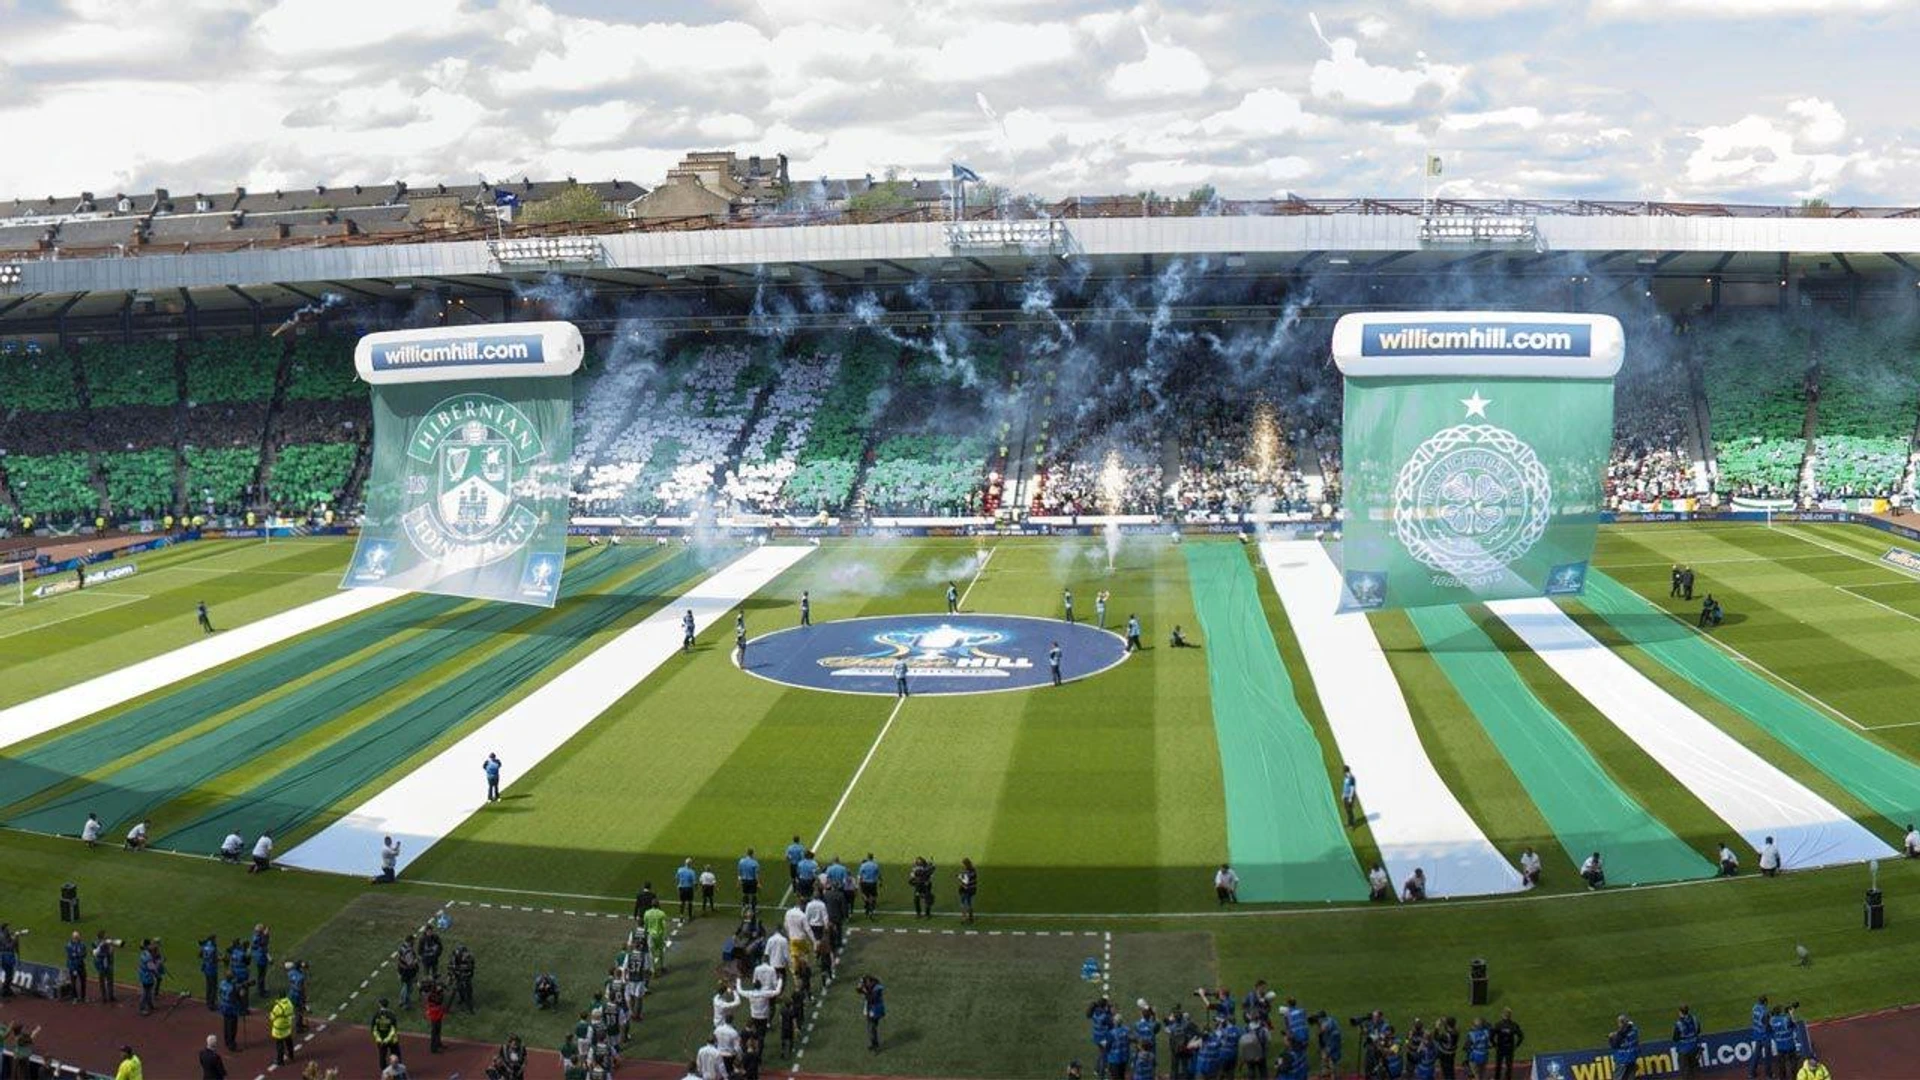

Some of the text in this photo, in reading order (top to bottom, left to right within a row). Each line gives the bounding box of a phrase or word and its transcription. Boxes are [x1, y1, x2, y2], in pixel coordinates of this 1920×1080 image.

[1379, 326, 1571, 350] williamhill.com
[384, 341, 528, 364] williamhill.com
[418, 400, 533, 451] HIBERNIAN
[956, 658, 1034, 668] HILL
